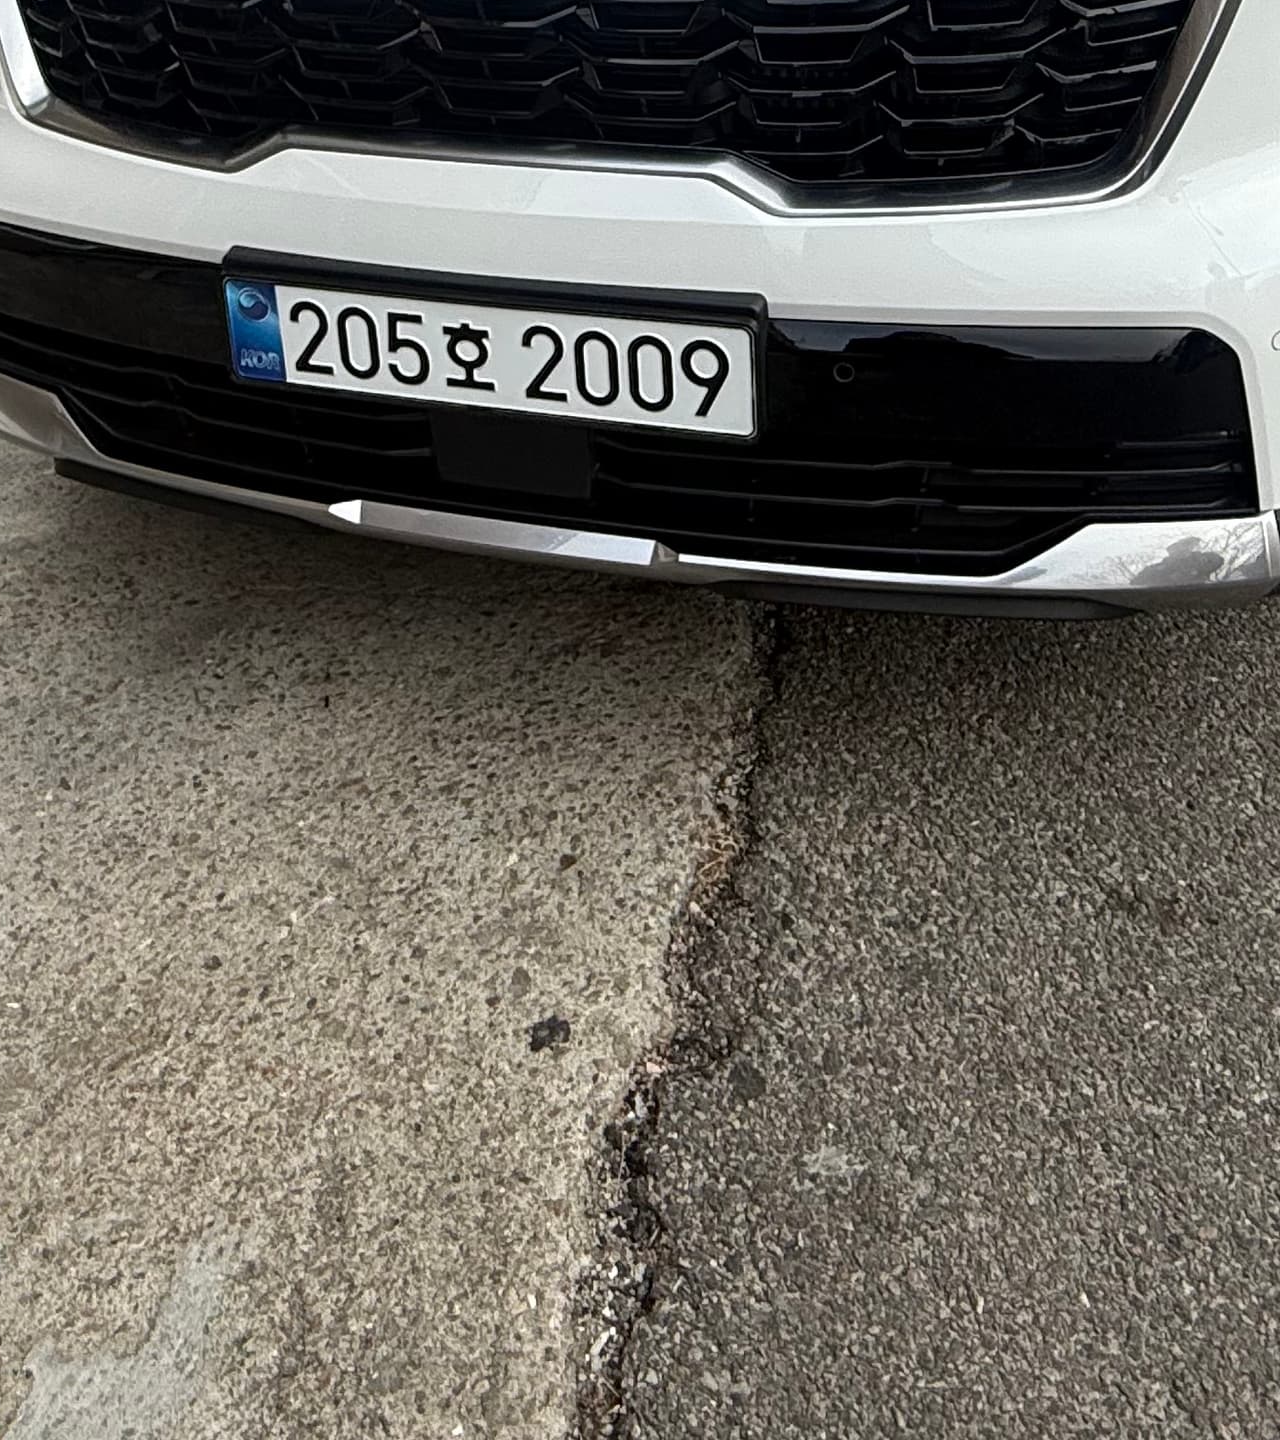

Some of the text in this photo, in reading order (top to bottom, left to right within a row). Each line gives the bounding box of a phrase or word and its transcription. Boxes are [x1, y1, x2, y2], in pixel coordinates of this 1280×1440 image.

[240, 347, 280, 371] KOR
[288, 300, 731, 418] 205호 2009
